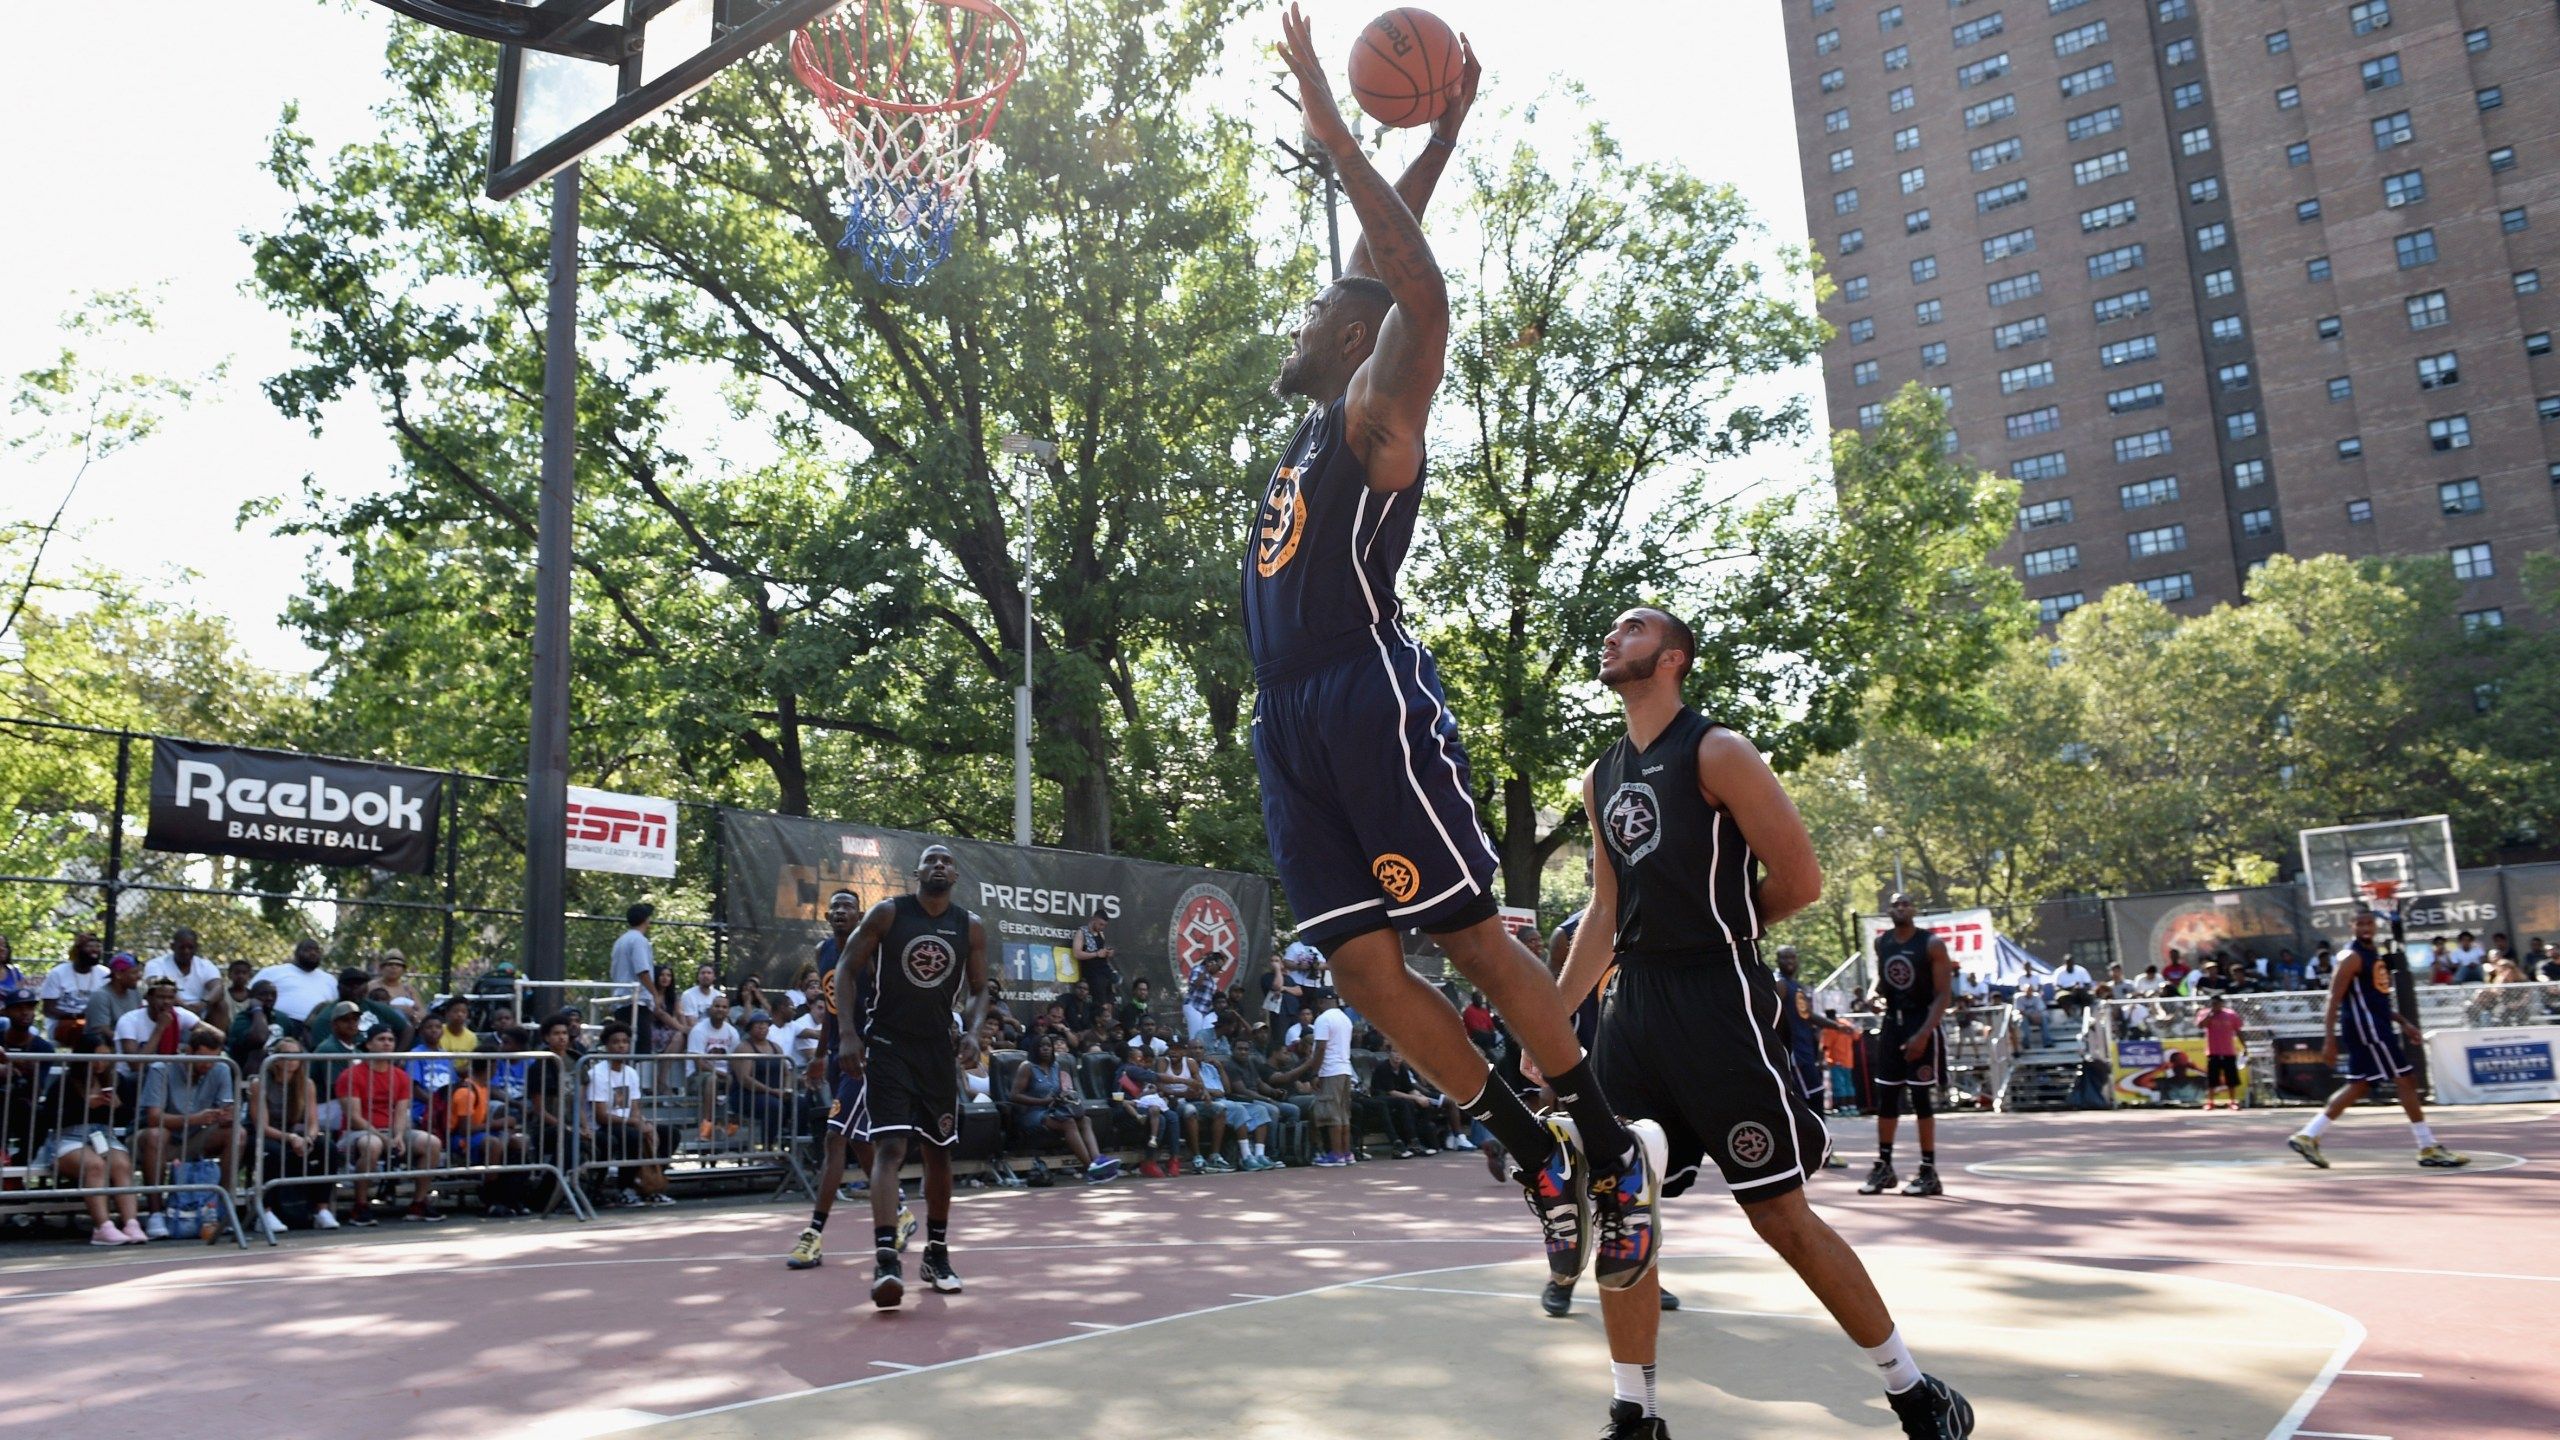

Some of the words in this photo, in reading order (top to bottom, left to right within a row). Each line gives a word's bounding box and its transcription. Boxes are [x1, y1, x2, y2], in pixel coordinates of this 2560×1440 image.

[175, 759, 423, 831] Reebok
[228, 821, 383, 851] BASKETBALL
[979, 881, 1122, 919] PRESENTS
